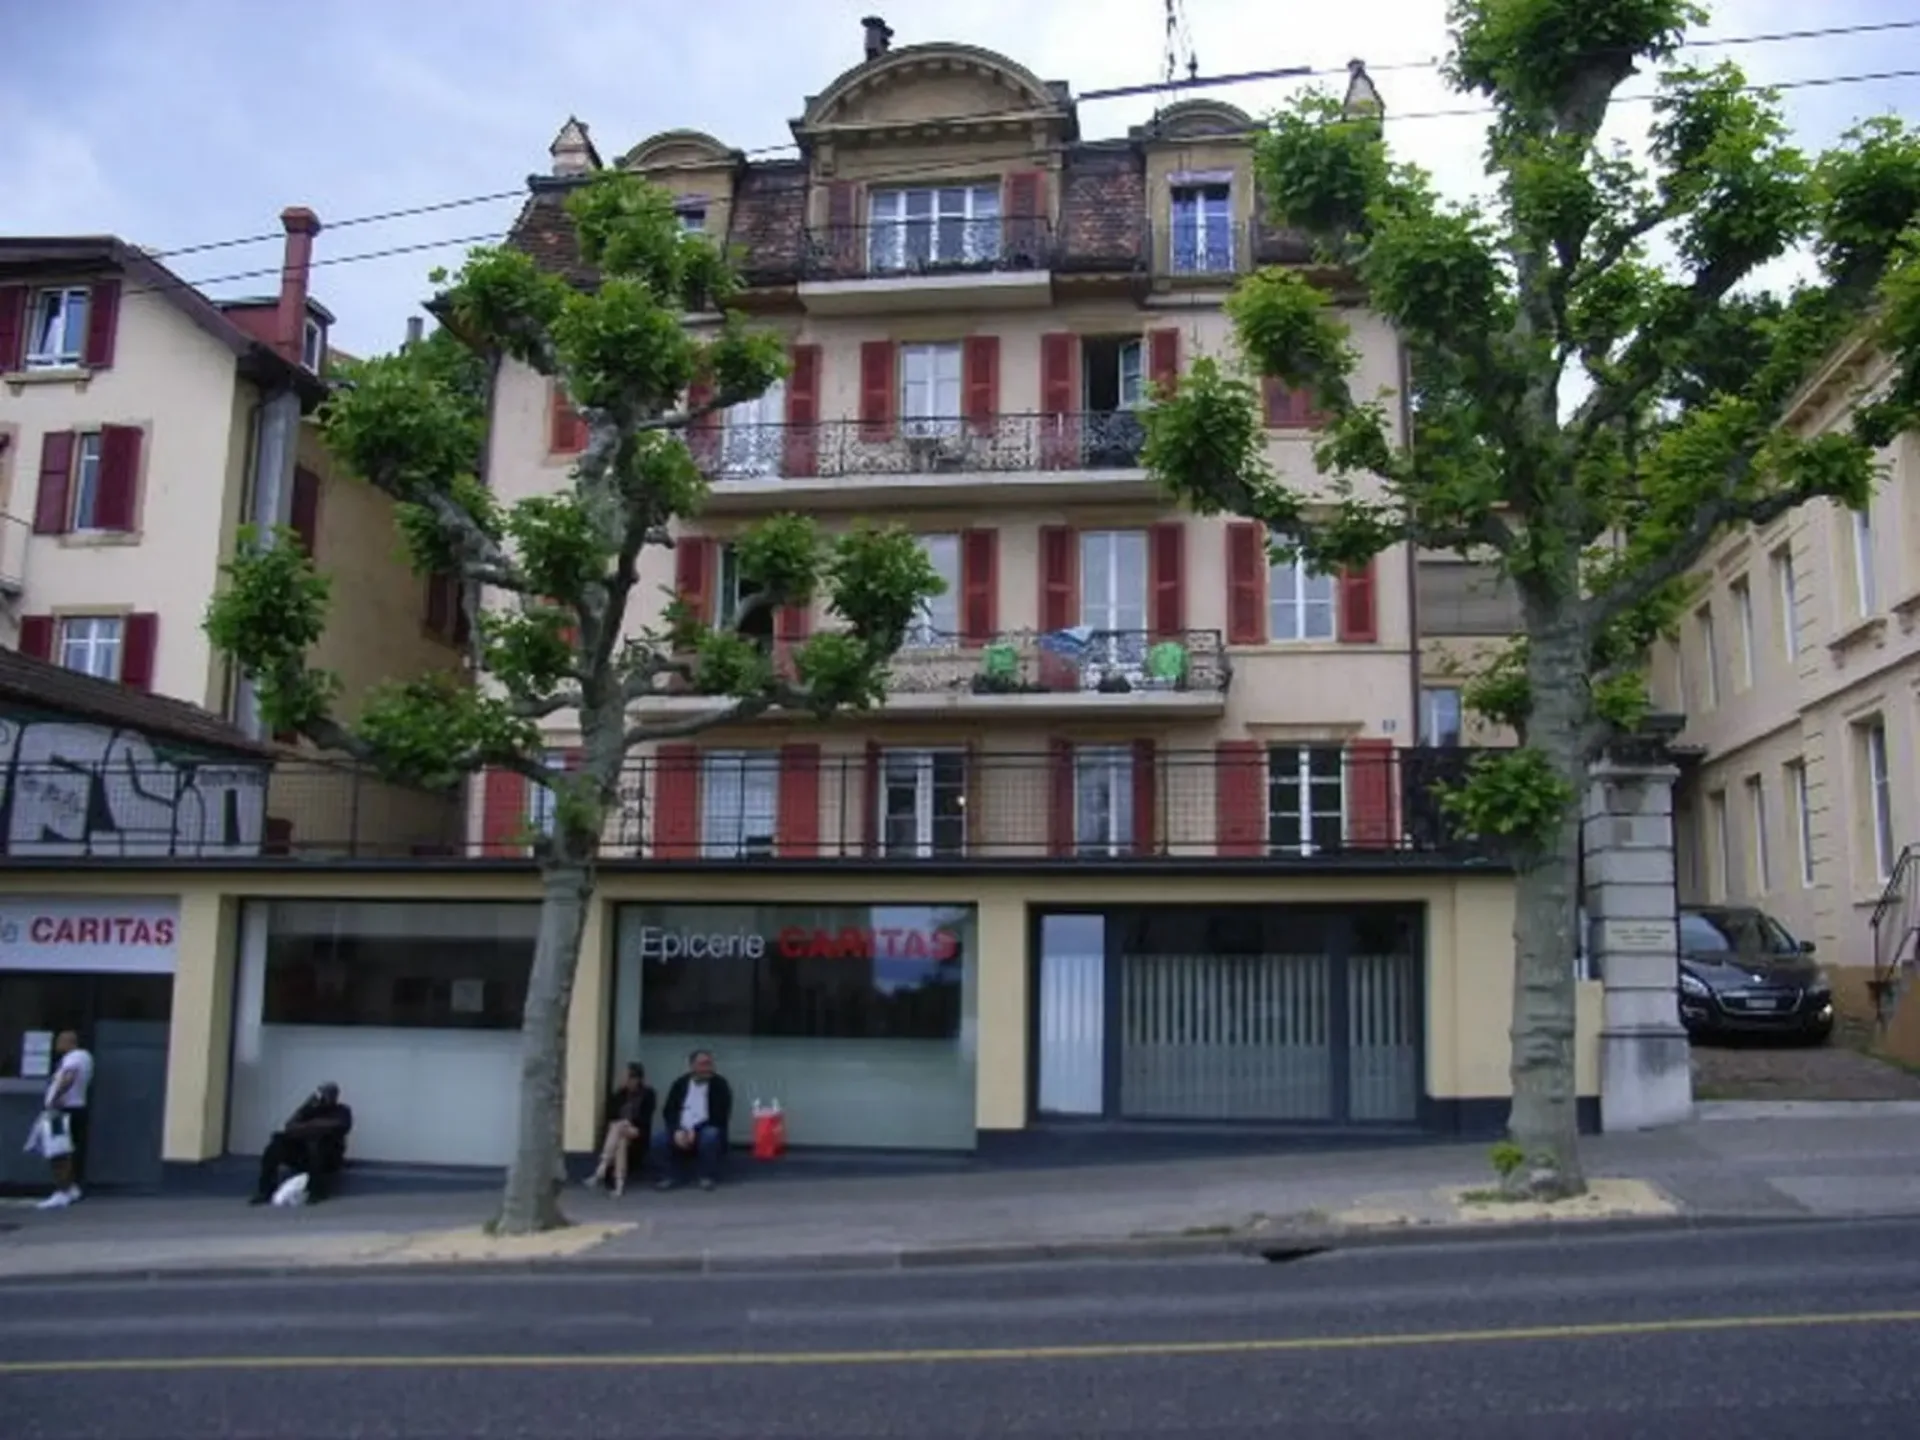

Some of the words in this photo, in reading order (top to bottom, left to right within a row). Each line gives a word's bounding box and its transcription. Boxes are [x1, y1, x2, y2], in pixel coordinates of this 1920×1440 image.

[31, 916, 174, 945] CARITAS
[640, 926, 765, 963] Epicerie
[777, 925, 958, 960] CARITAS
